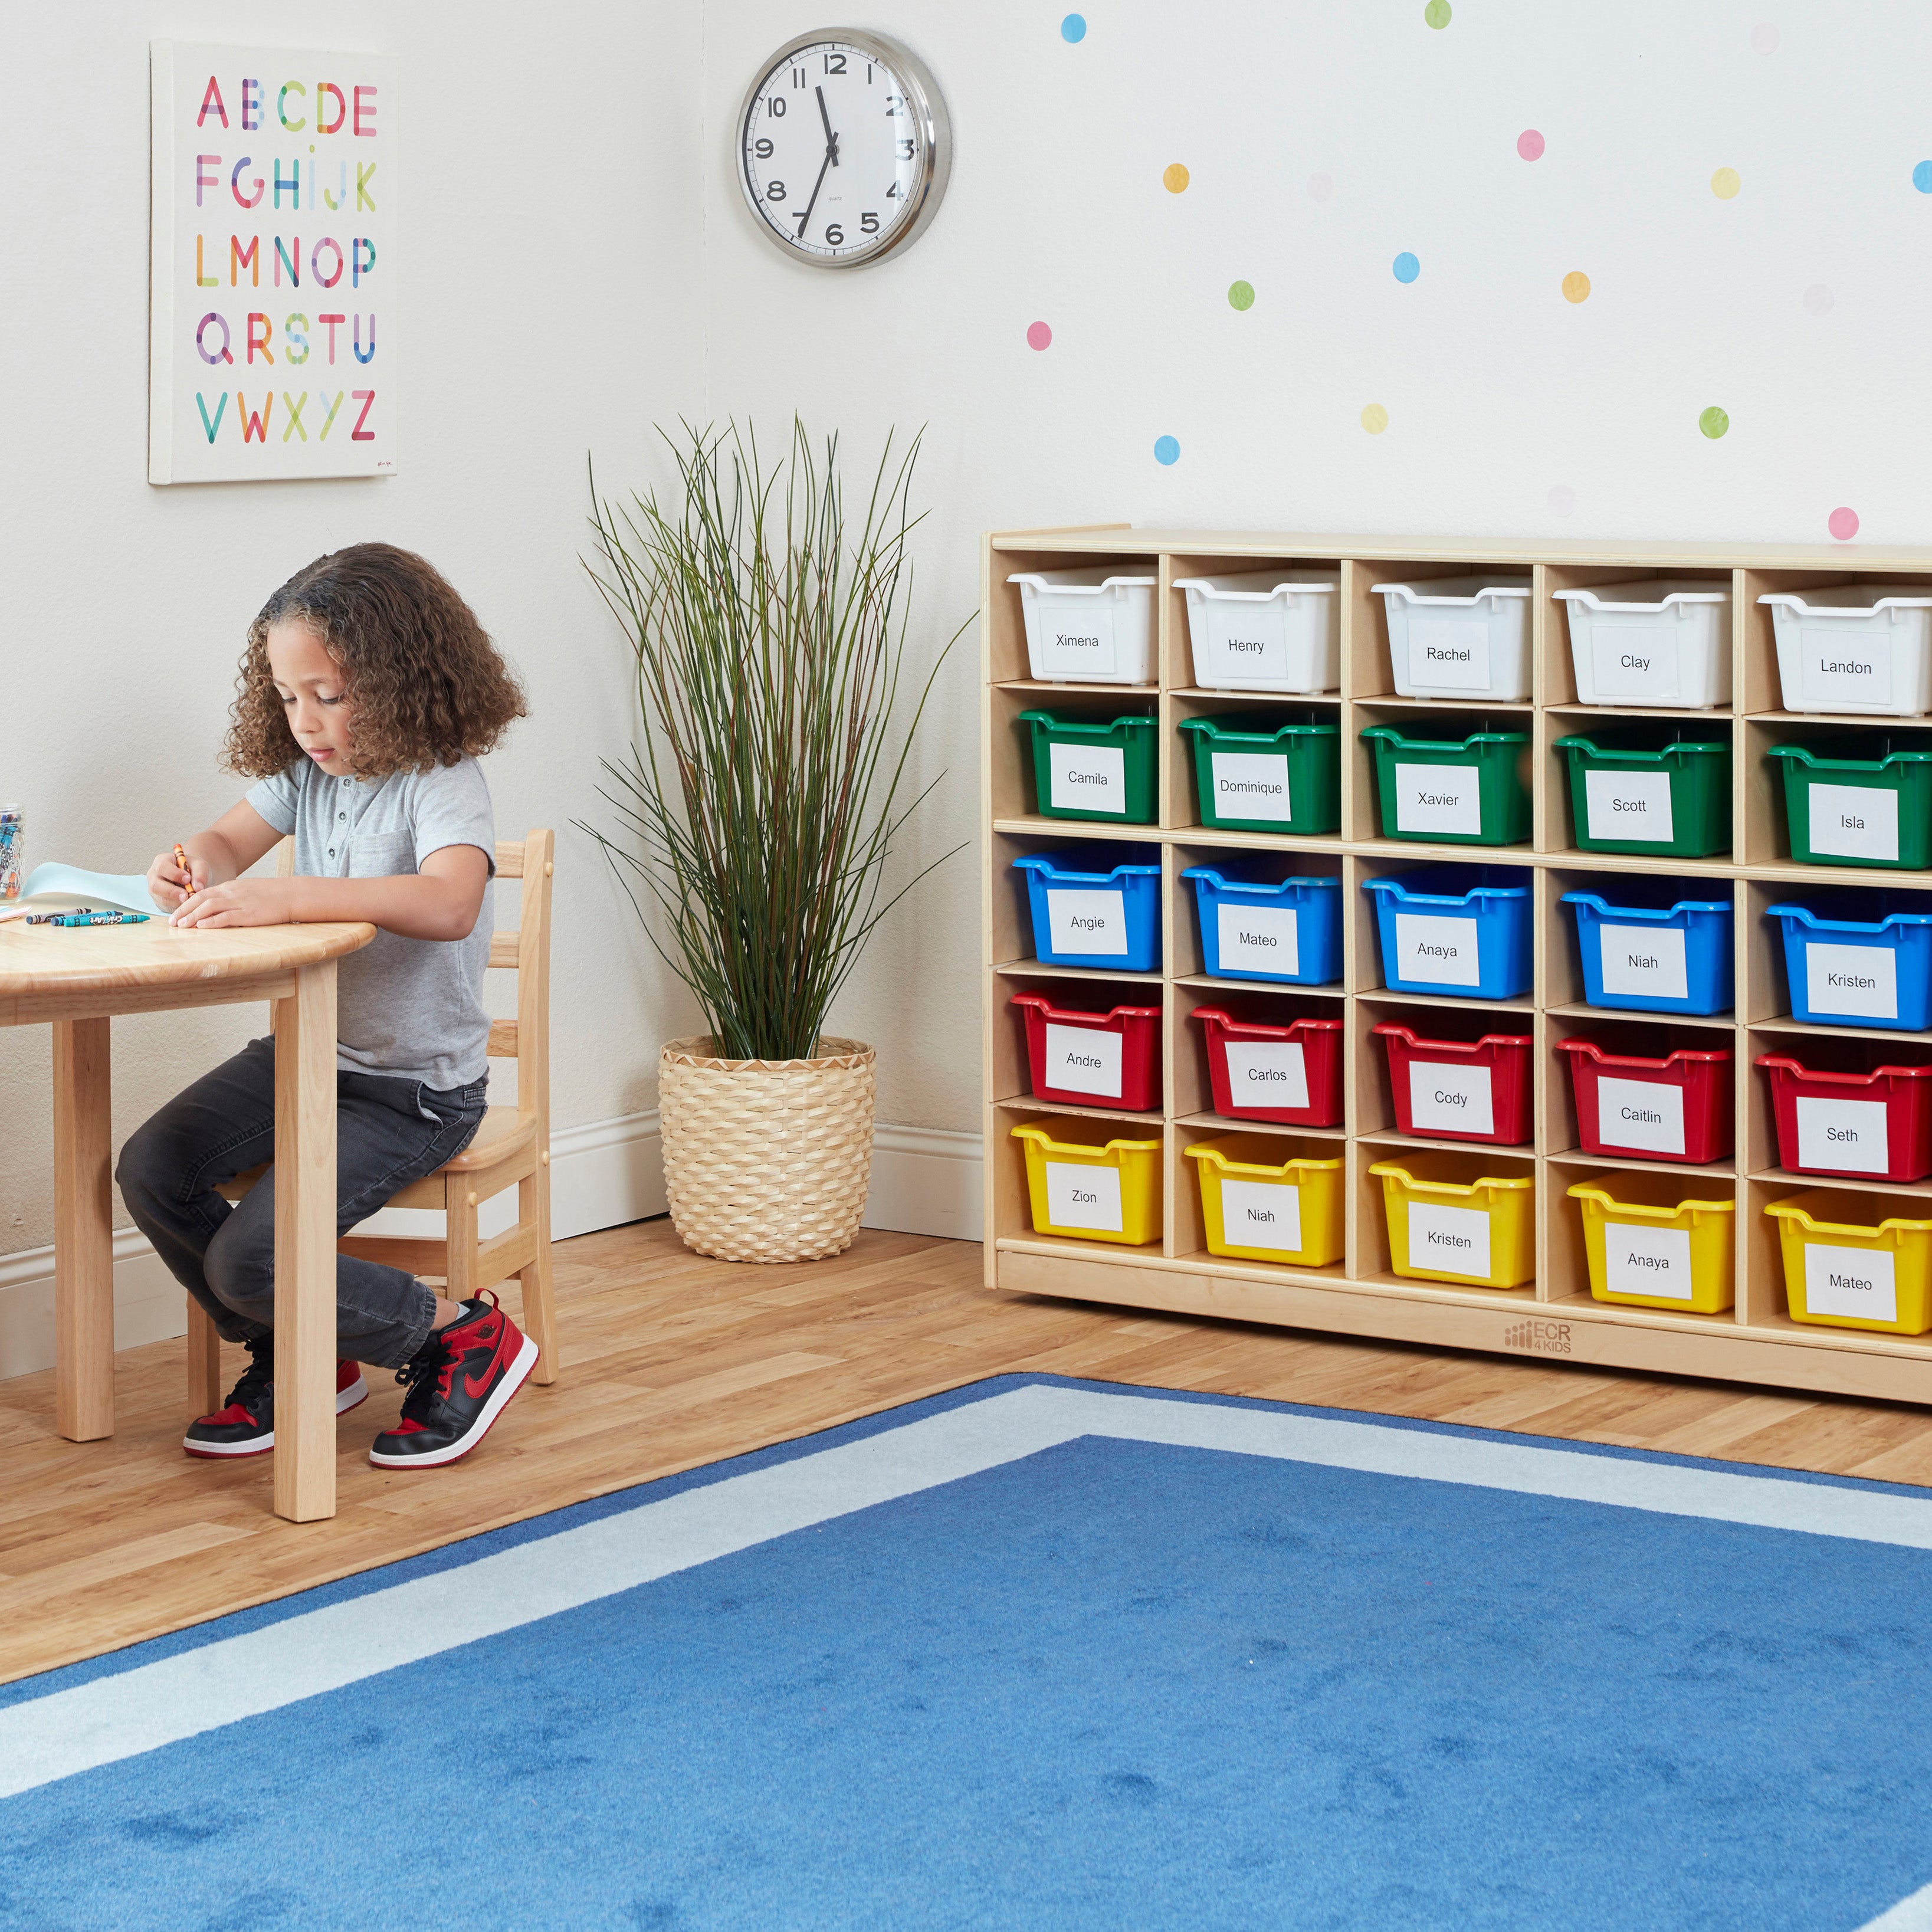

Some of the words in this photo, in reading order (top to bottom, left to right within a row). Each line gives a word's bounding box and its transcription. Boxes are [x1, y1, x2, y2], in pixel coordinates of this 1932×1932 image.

[824, 54, 847, 74] 12
[793, 68, 805, 88] 11
[868, 64, 872, 84] 1
[768, 97, 786, 117] 10
[886, 96, 904, 116] 2
[755, 138, 774, 159] 9
[896, 139, 914, 161] 3
[767, 181, 787, 201] 8
[886, 180, 904, 201] 4
[860, 212, 880, 233] 5
[825, 224, 844, 245] 6
[1056, 634, 1098, 647] Ximena
[1229, 639, 1264, 655] Henry
[1427, 647, 1470, 661] Rachel
[1621, 655, 1650, 671] Clay
[1821, 659, 1871, 674] Landon
[1068, 770, 1107, 785] Camila
[1221, 779, 1282, 796] Dominique
[1418, 792, 1459, 806] Xavier
[1613, 798, 1646, 812] Scott
[1842, 815, 1864, 829] Isla
[1071, 916, 1105, 931] Angie
[1239, 932, 1277, 947] Mateo
[1417, 943, 1457, 959] Anaya
[1629, 954, 1658, 969] Niah
[1828, 973, 1875, 989] Kristen
[1066, 1052, 1101, 1068] Andre
[1248, 1068, 1287, 1081] Carlos
[1435, 1091, 1468, 1108] Cody
[1621, 1107, 1661, 1124] Caitlin
[1827, 1127, 1858, 1142] Seth
[1072, 1189, 1097, 1203] Zion
[1248, 1208, 1275, 1222] Niah
[1428, 1231, 1471, 1248] Kristen
[1628, 1252, 1669, 1271] Anaya
[1830, 1274, 1872, 1291] Mateo
[1534, 1321, 1571, 1341] ECR
